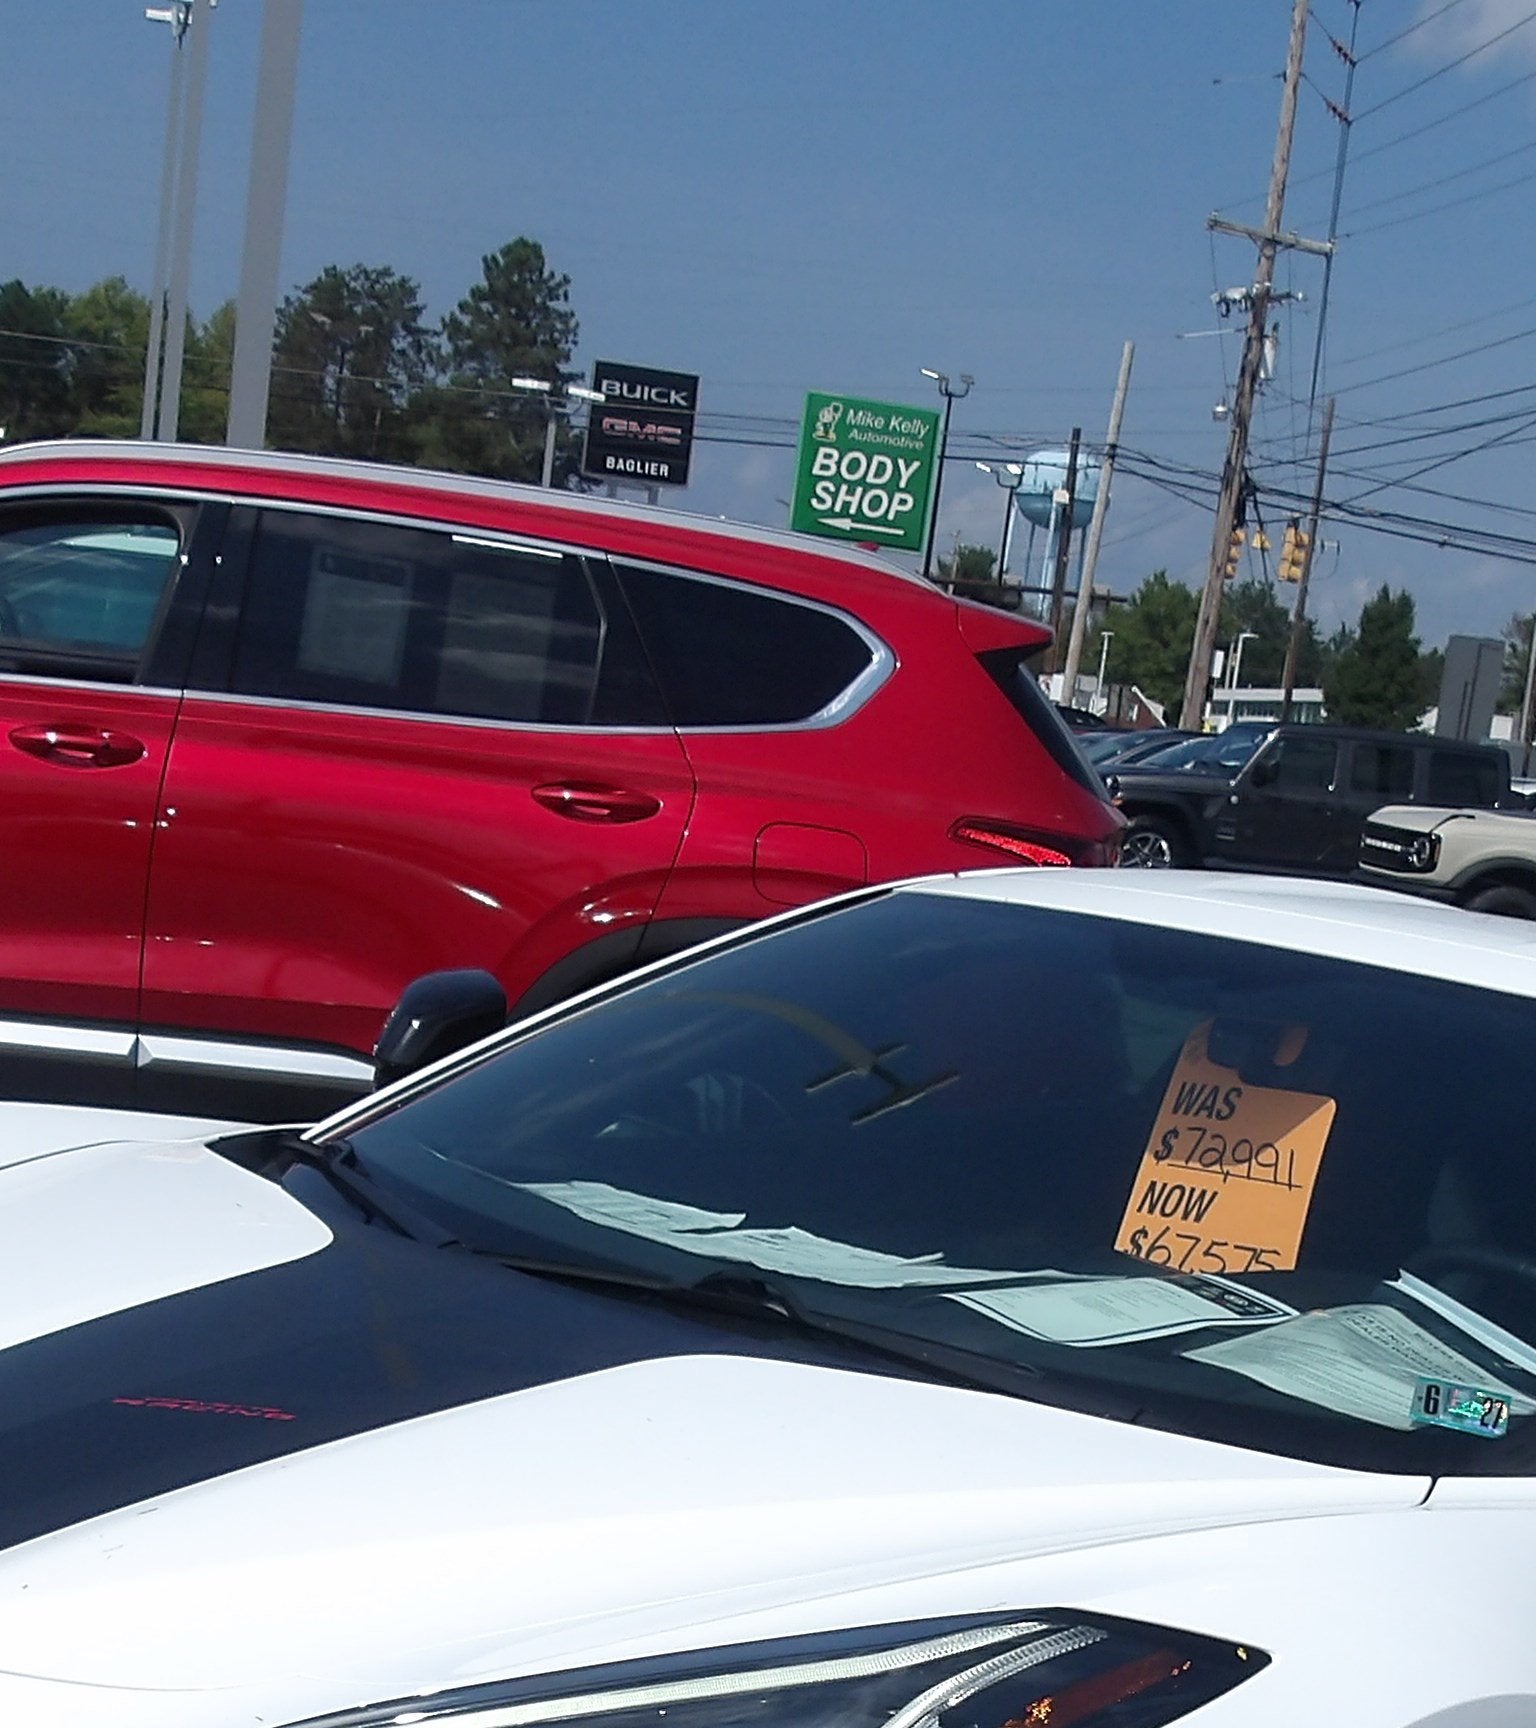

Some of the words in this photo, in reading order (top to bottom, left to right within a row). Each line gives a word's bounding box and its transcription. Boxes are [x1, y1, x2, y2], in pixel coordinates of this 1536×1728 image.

[601, 379, 689, 407] BUICK
[602, 417, 682, 446] GMC
[846, 408, 885, 430] Mike
[889, 415, 930, 440] Kelly
[848, 428, 924, 451] Automotive
[606, 455, 669, 478] BAGLIER
[811, 446, 921, 489] BODY
[810, 480, 914, 521] SHOP
[1171, 1081, 1243, 1121] WAS
[1136, 1179, 1218, 1224] NOW
[1424, 1384, 1441, 1415] 6
[1480, 1397, 1505, 1430] 27
